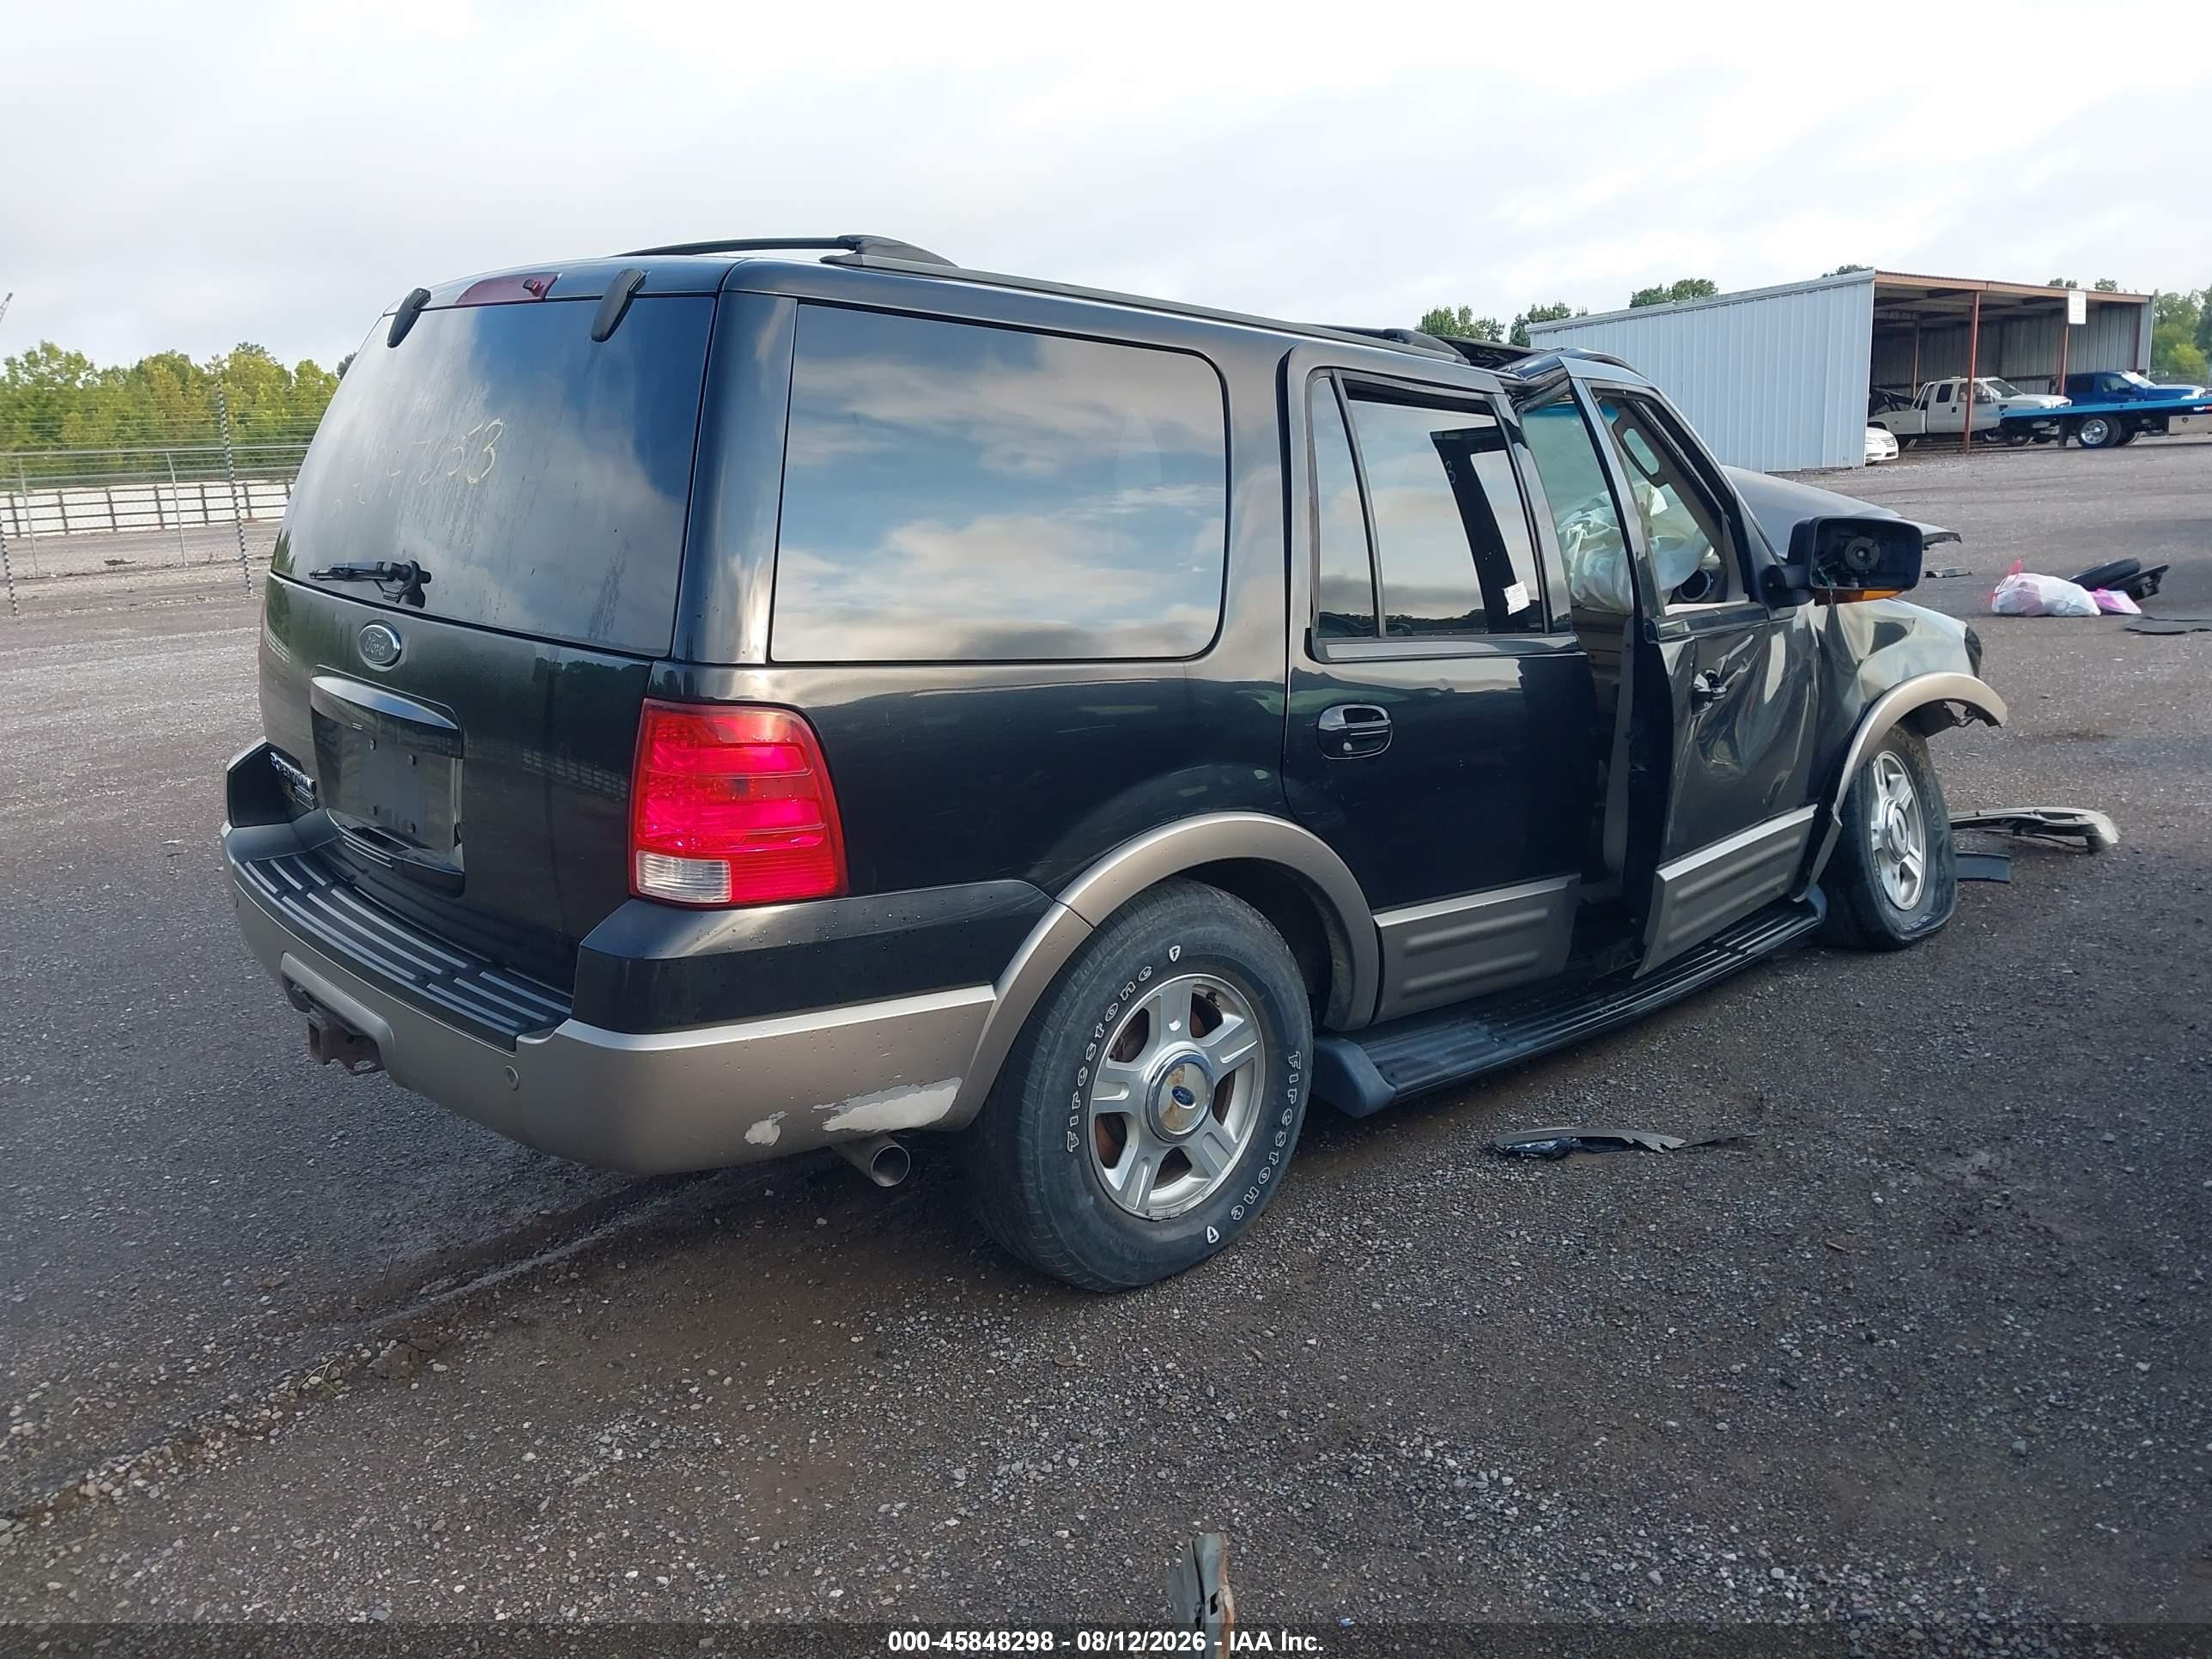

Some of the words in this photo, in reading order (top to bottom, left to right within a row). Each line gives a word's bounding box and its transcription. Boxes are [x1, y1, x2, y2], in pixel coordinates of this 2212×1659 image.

[365, 631, 387, 657] Ford
[1066, 966, 1152, 1152] Firestone
[1231, 1051, 1301, 1220] Firestone
